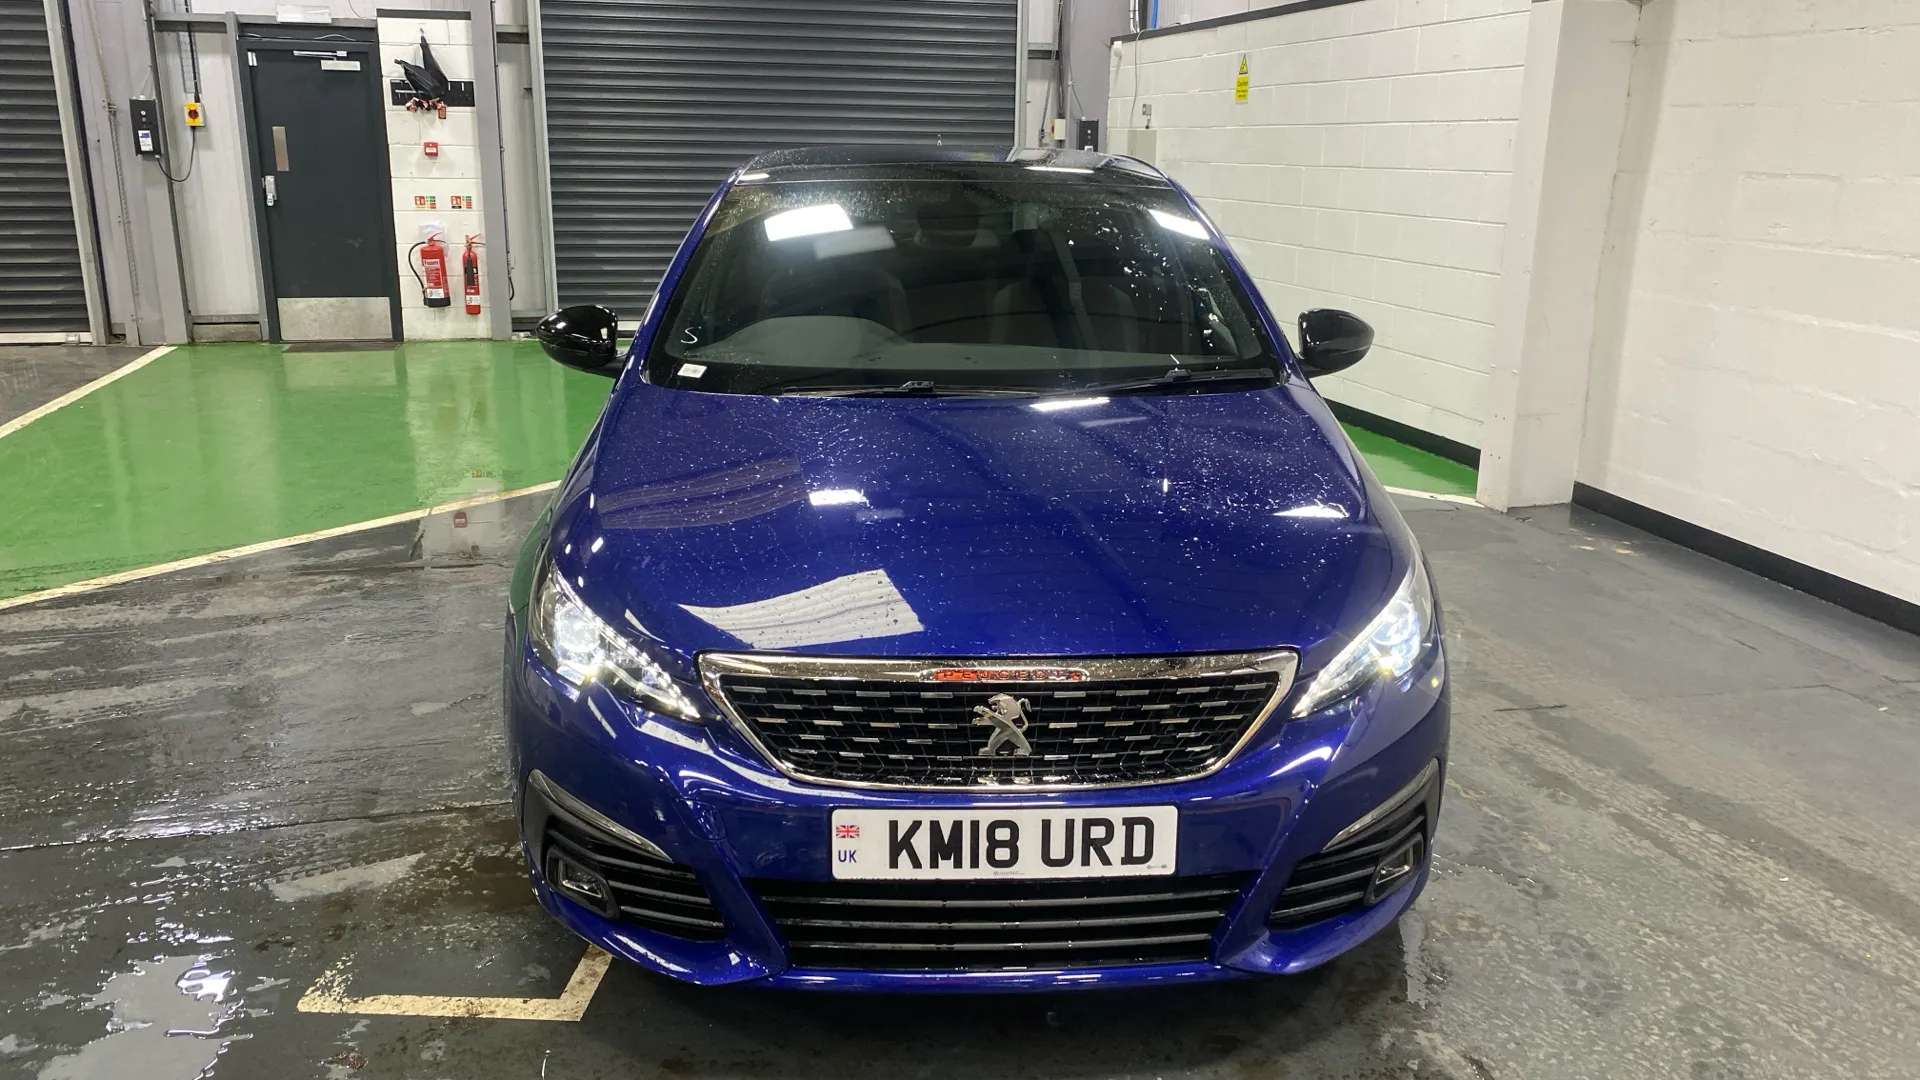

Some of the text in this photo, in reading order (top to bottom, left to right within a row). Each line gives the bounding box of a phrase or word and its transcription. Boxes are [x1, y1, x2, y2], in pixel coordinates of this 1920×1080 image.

[838, 850, 857, 863] UK
[888, 816, 1155, 869] KM18 URD
